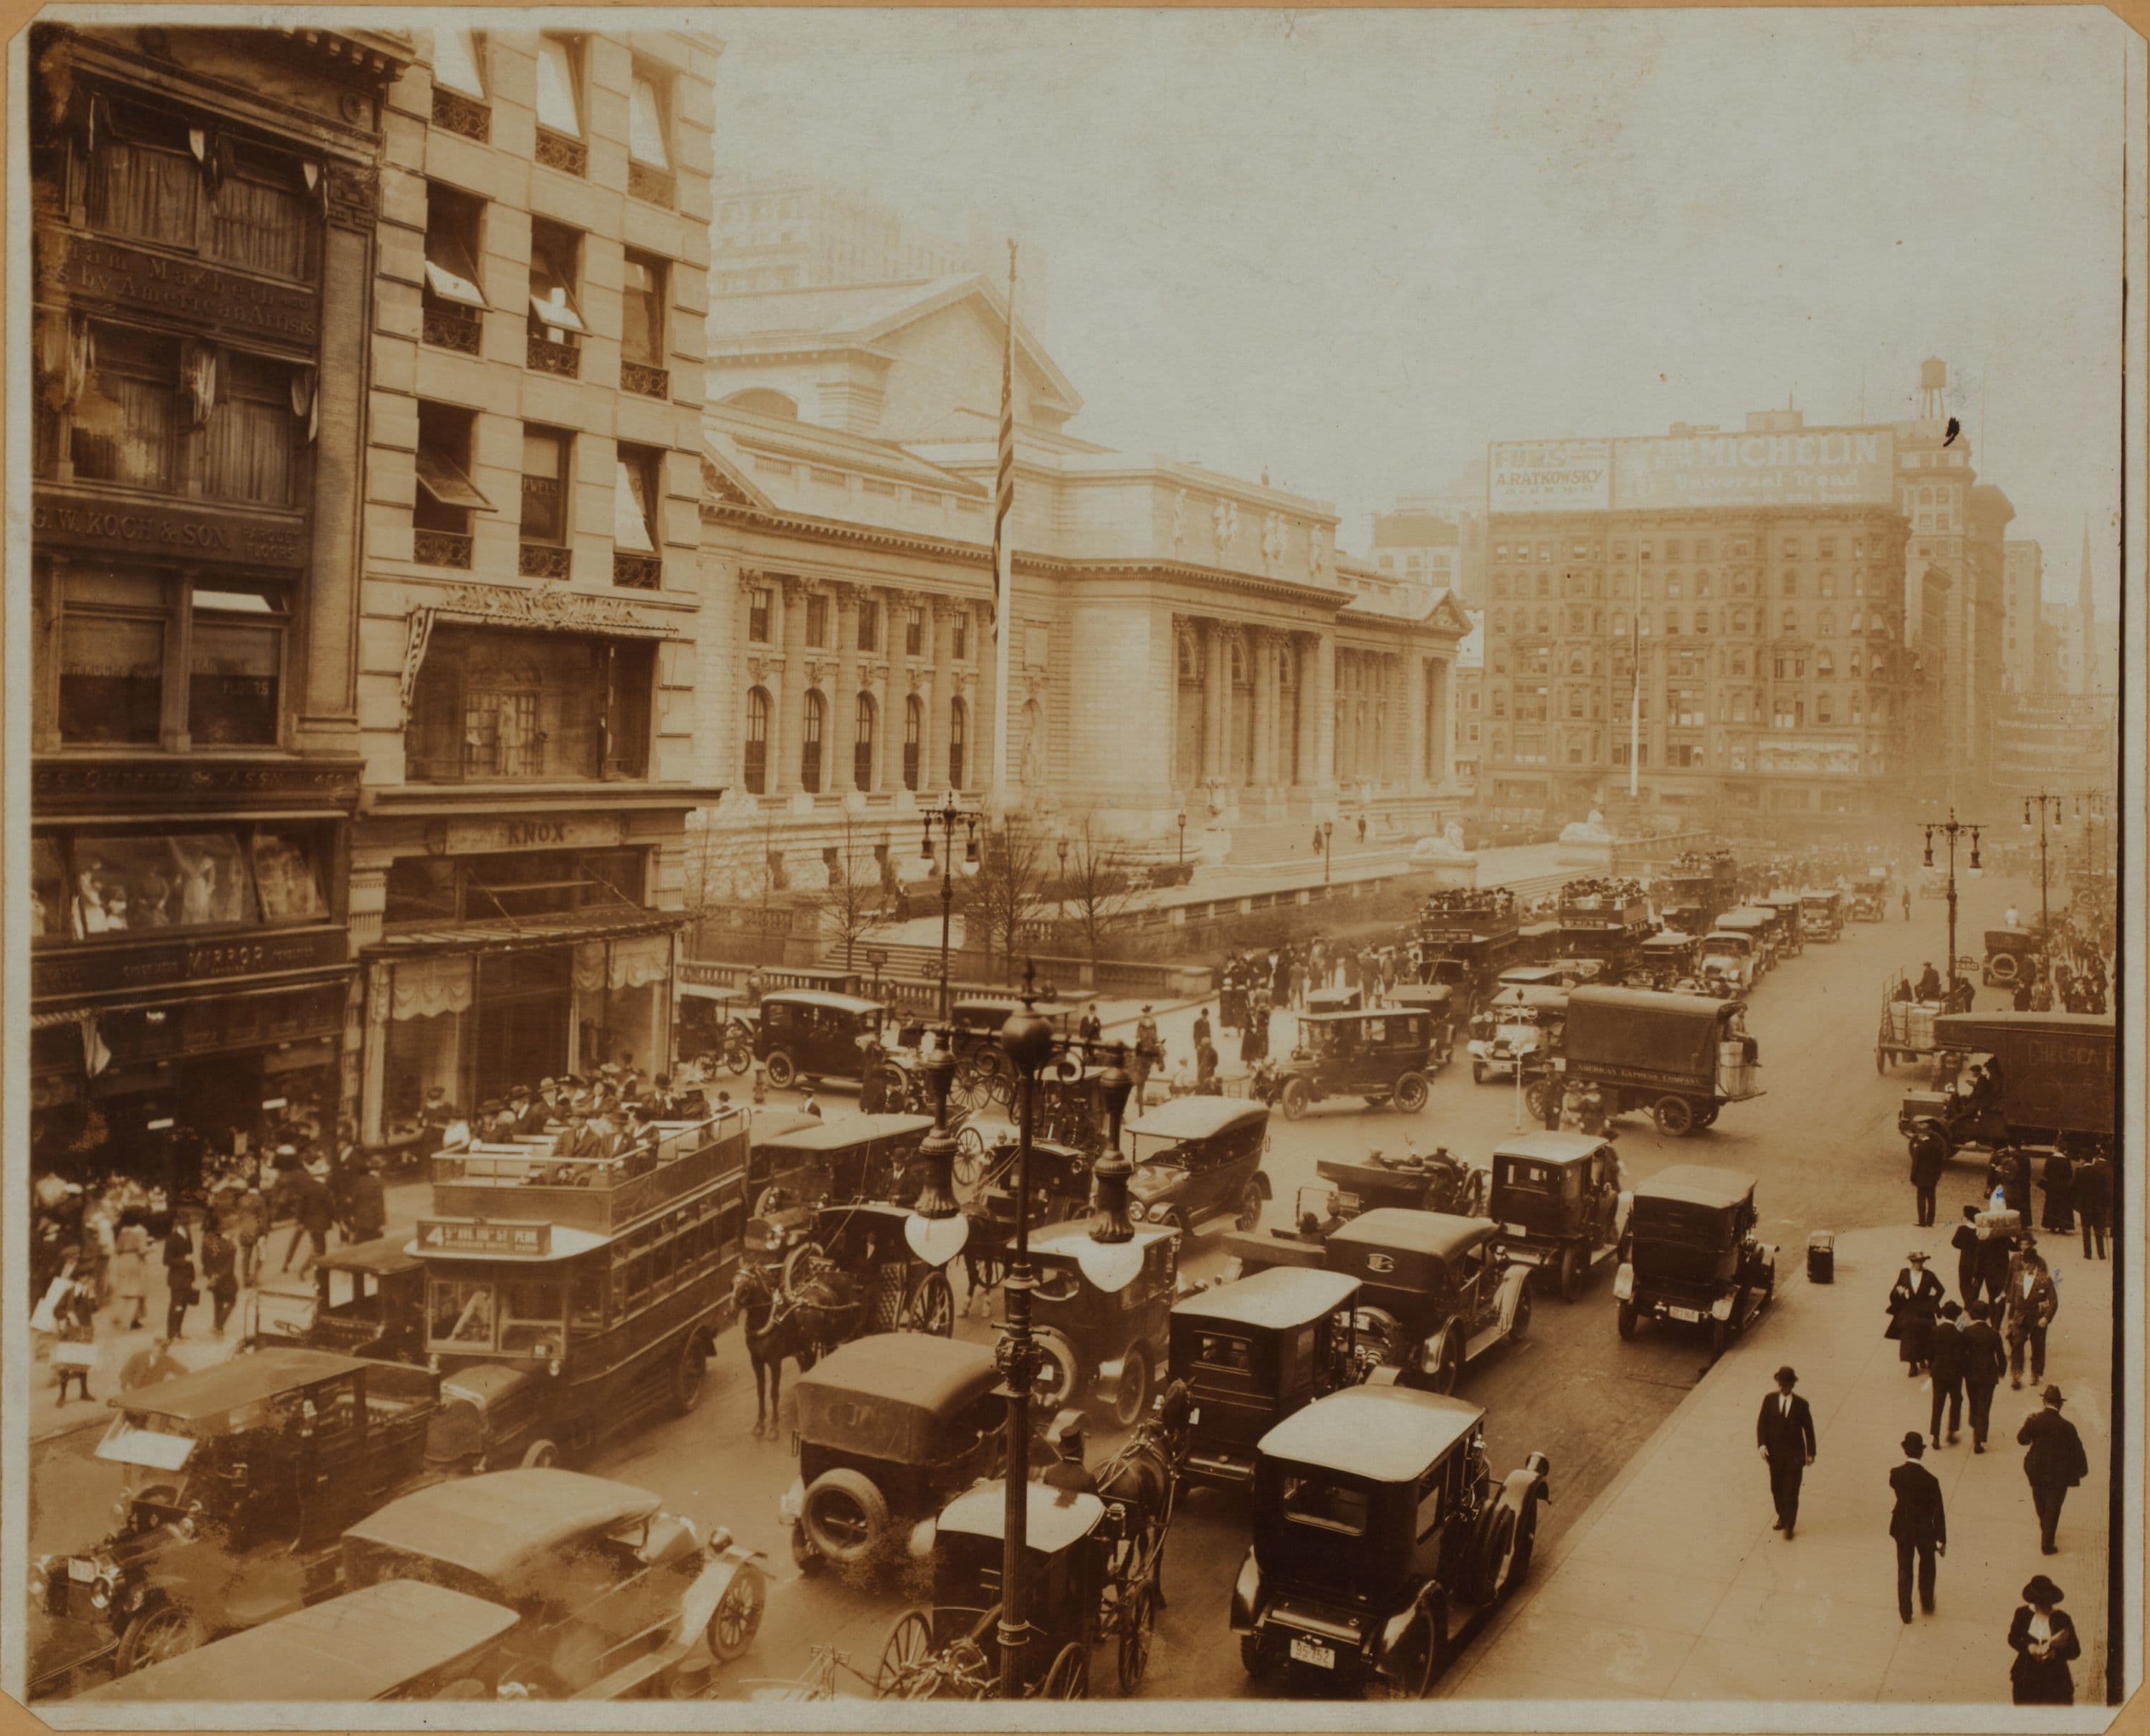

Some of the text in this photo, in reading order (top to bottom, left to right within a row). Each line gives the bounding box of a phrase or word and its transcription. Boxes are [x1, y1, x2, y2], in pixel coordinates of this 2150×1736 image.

[149, 257, 274, 305] Macbeth
[81, 264, 112, 296] by
[118, 275, 245, 323] American
[246, 305, 315, 335] Artists
[1699, 435, 1877, 468] MICHELIN
[86, 512, 153, 541] KOCH
[160, 521, 178, 543] &
[507, 822, 565, 845] KNOX
[184, 949, 266, 980] MIRROR
[424, 1225, 443, 1247] 4
